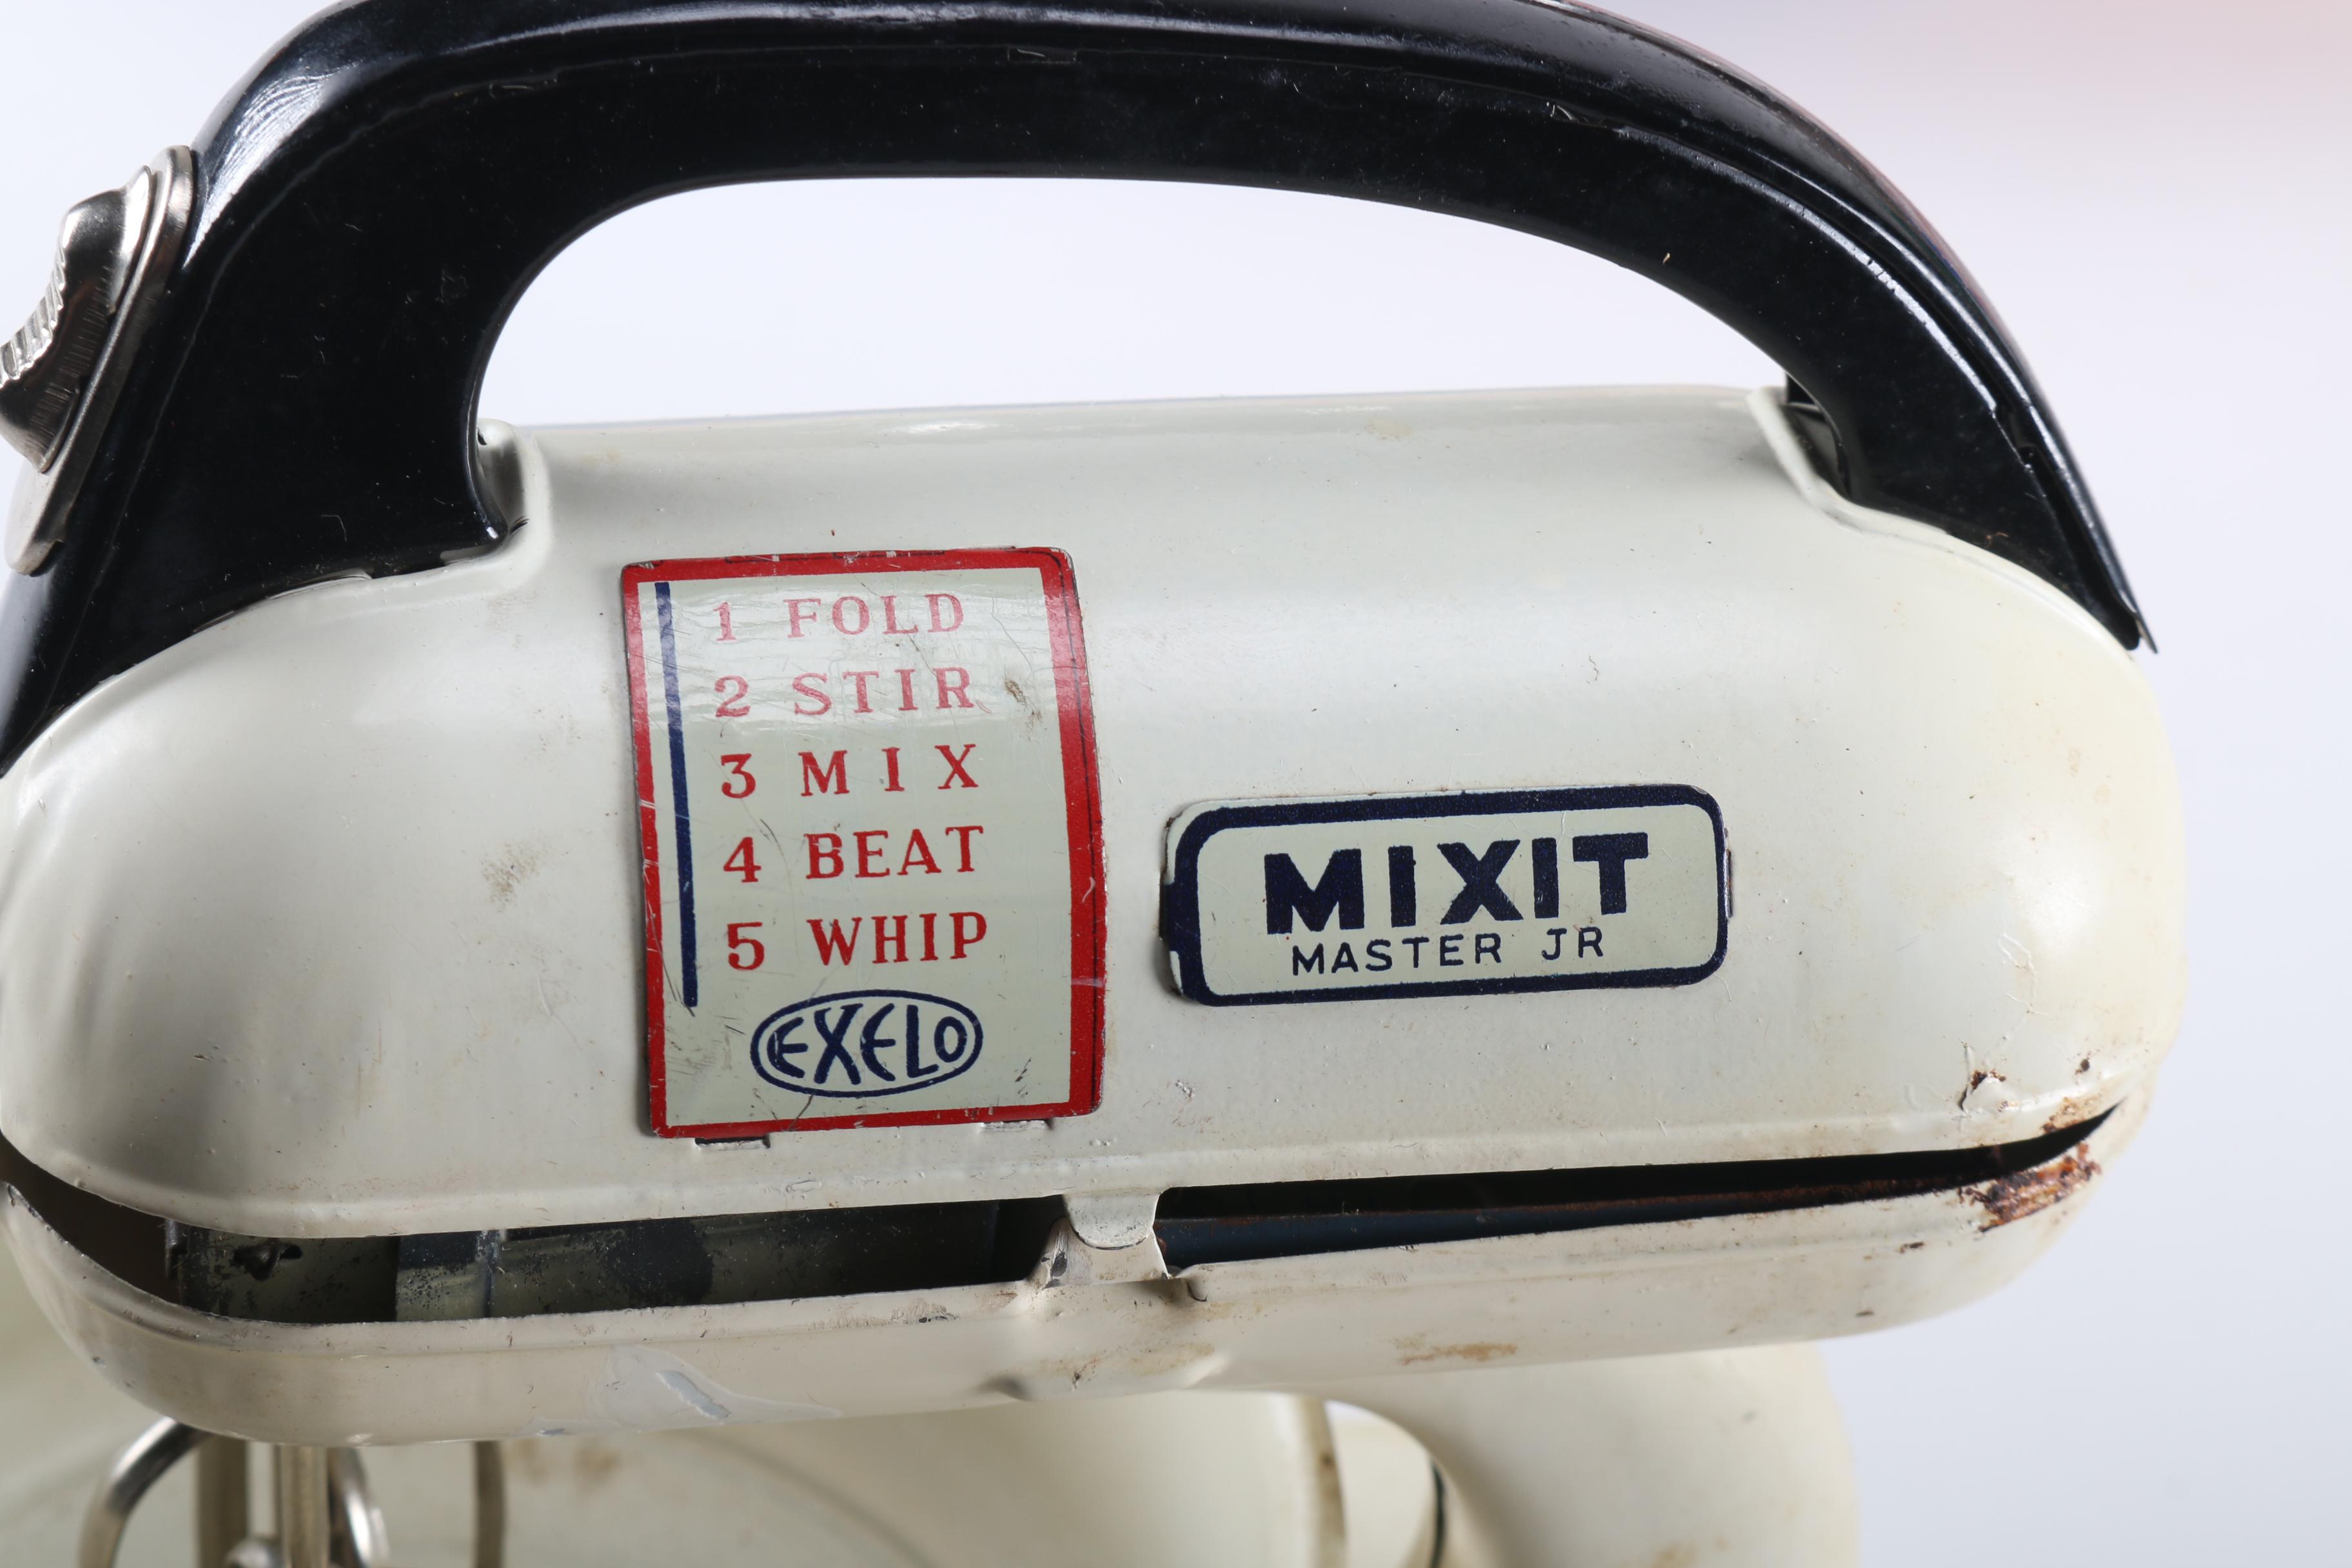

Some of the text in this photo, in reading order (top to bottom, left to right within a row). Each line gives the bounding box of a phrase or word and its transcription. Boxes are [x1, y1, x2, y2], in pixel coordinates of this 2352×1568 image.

[714, 594, 965, 642] 1 FOLD
[714, 667, 975, 718] 2 STIR
[721, 743, 979, 799] 3 MIX
[723, 825, 985, 883] 4 BEAT
[1264, 832, 1649, 935] MIXIT
[727, 911, 988, 972] 5 WHIP
[1291, 926, 1605, 977] MASTER JR
[767, 1003, 967, 1085] EXELO
